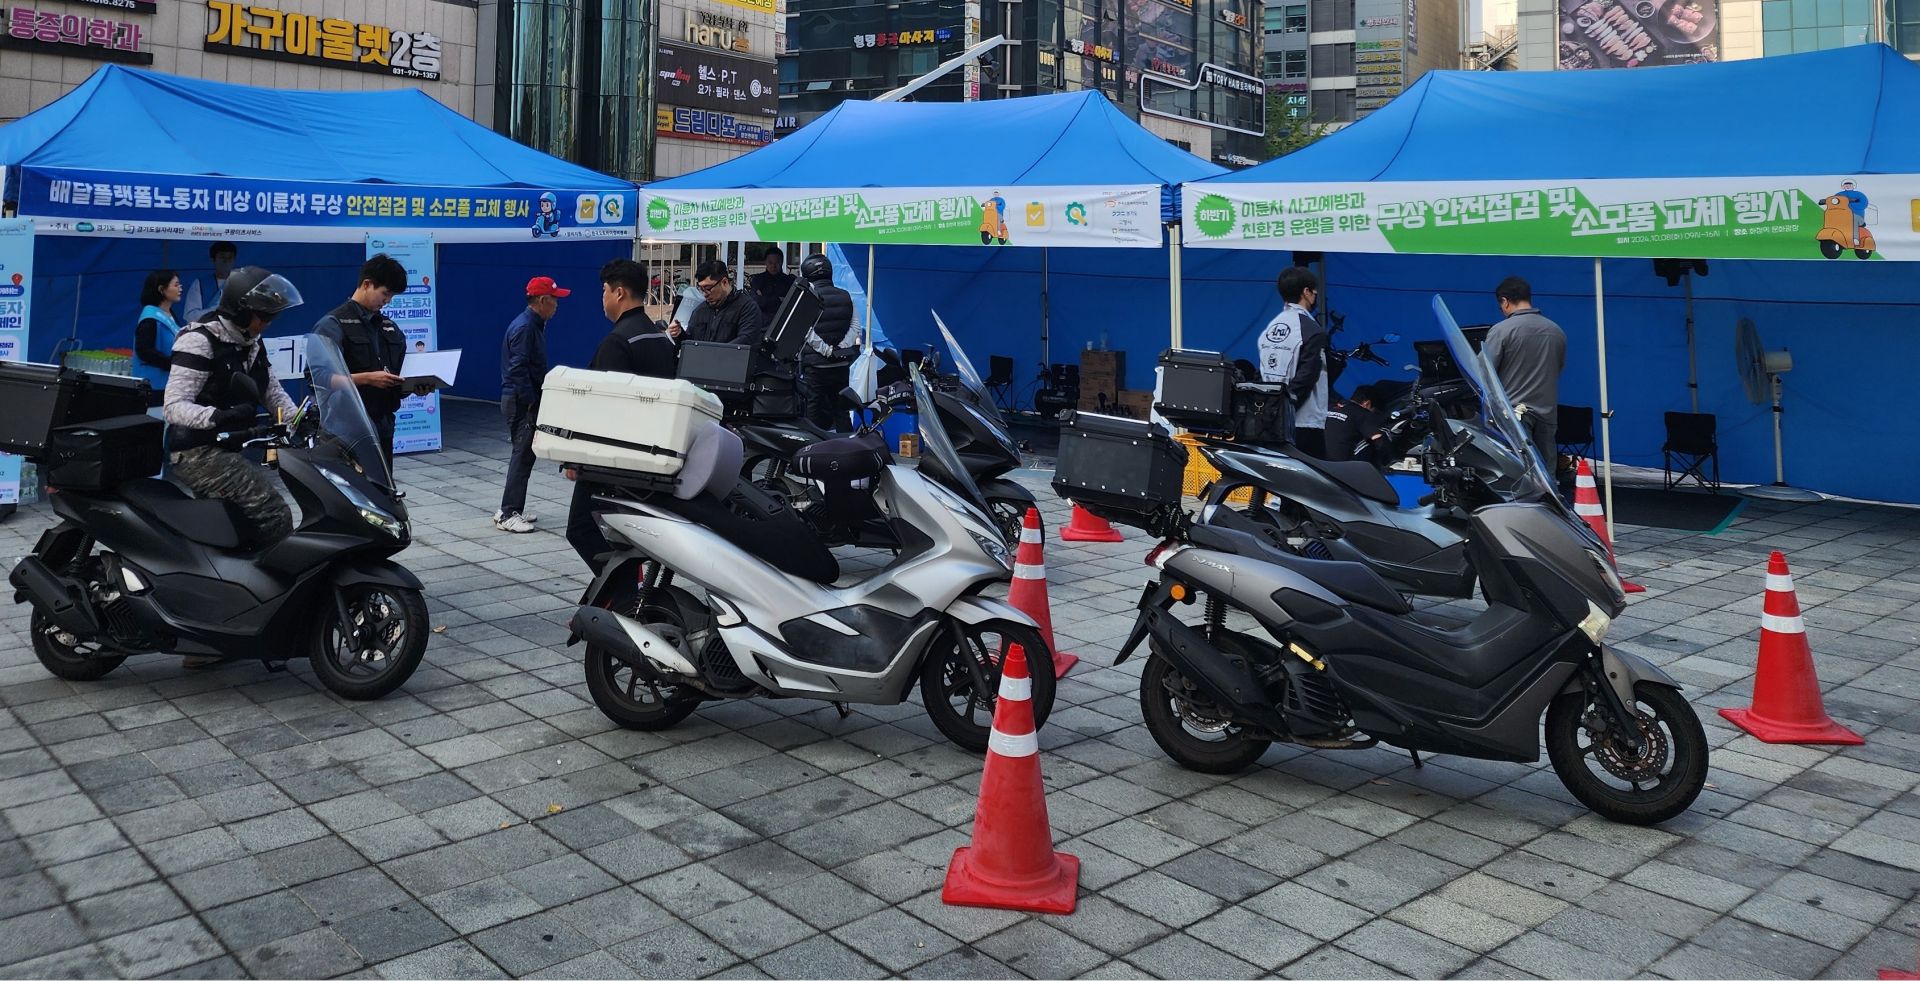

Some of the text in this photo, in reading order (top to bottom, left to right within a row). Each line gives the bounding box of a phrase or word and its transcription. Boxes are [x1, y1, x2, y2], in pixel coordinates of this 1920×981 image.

[9, 7, 143, 52] 통증의학과
[207, 1, 441, 72] 가구아울렛 2층
[392, 67, 437, 79] 031-979-1357
[674, 107, 736, 138] 드림디포
[49, 179, 530, 218] 배달플랫폼노동자 대상 이륜차 무상 안전점검 및 소모품 교체 행사
[649, 208, 668, 219] 하반기
[673, 196, 745, 216] 이륜차 사고예방과
[750, 192, 859, 225] 무상 안전점검 및
[855, 196, 973, 230] 소모품 교체 행사
[1241, 192, 1366, 219] 이륜차 사고예방과
[1377, 186, 1578, 231] 무상 안전점검 및
[1571, 189, 1802, 237] 소모품 교체 행사
[673, 212, 747, 232] 친환경 운행을 위한
[1200, 209, 1230, 222] 하반기
[1241, 214, 1371, 240] 친환경 운행을 위한
